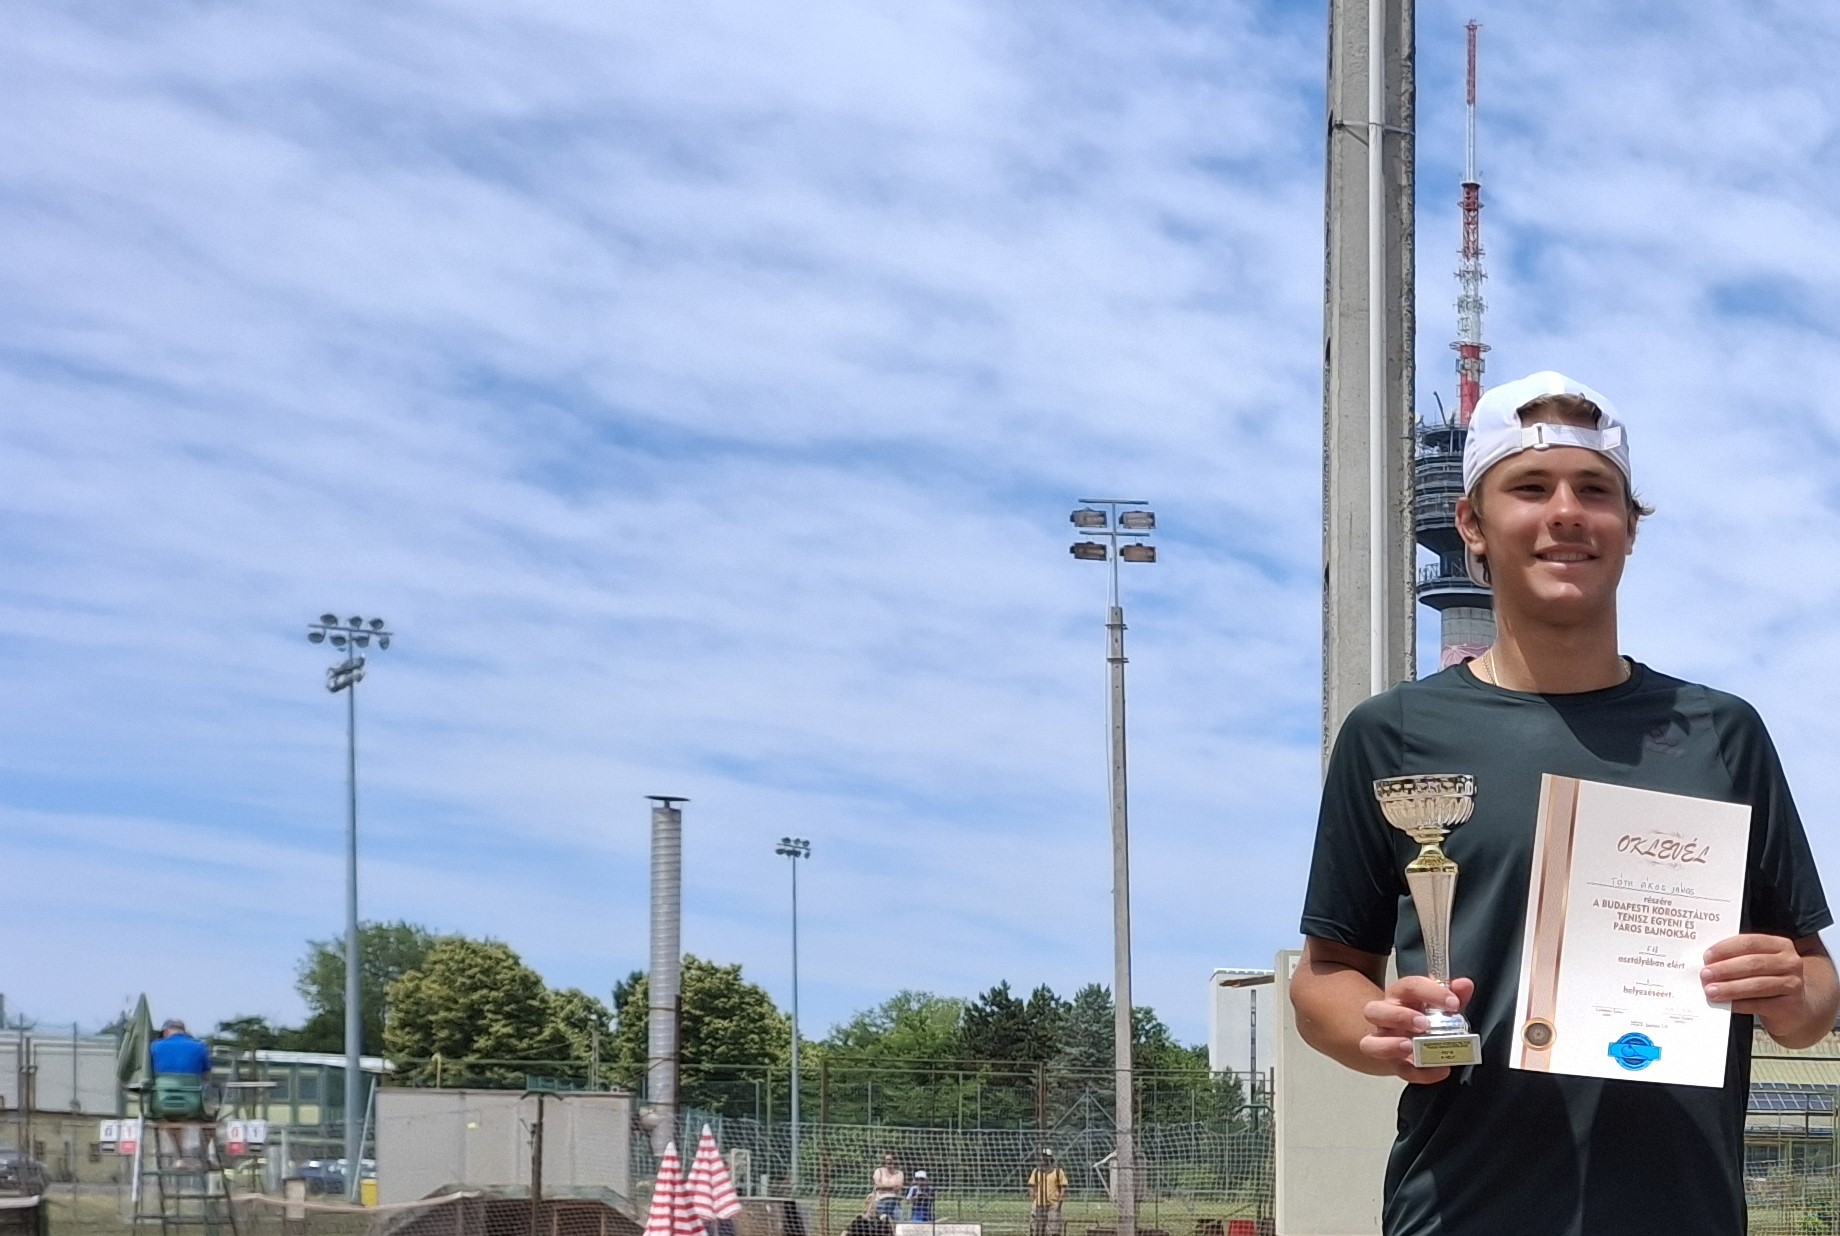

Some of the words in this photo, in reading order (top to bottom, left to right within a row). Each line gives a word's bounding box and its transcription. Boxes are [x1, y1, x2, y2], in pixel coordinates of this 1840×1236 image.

[1617, 834, 1710, 864] OKLEVÉL
[1593, 898, 1600, 908] A
[1601, 899, 1649, 914] BUDAPESTI
[1652, 906, 1720, 922] KOROSZTÁLYOS
[1617, 912, 1648, 924] TENISZ
